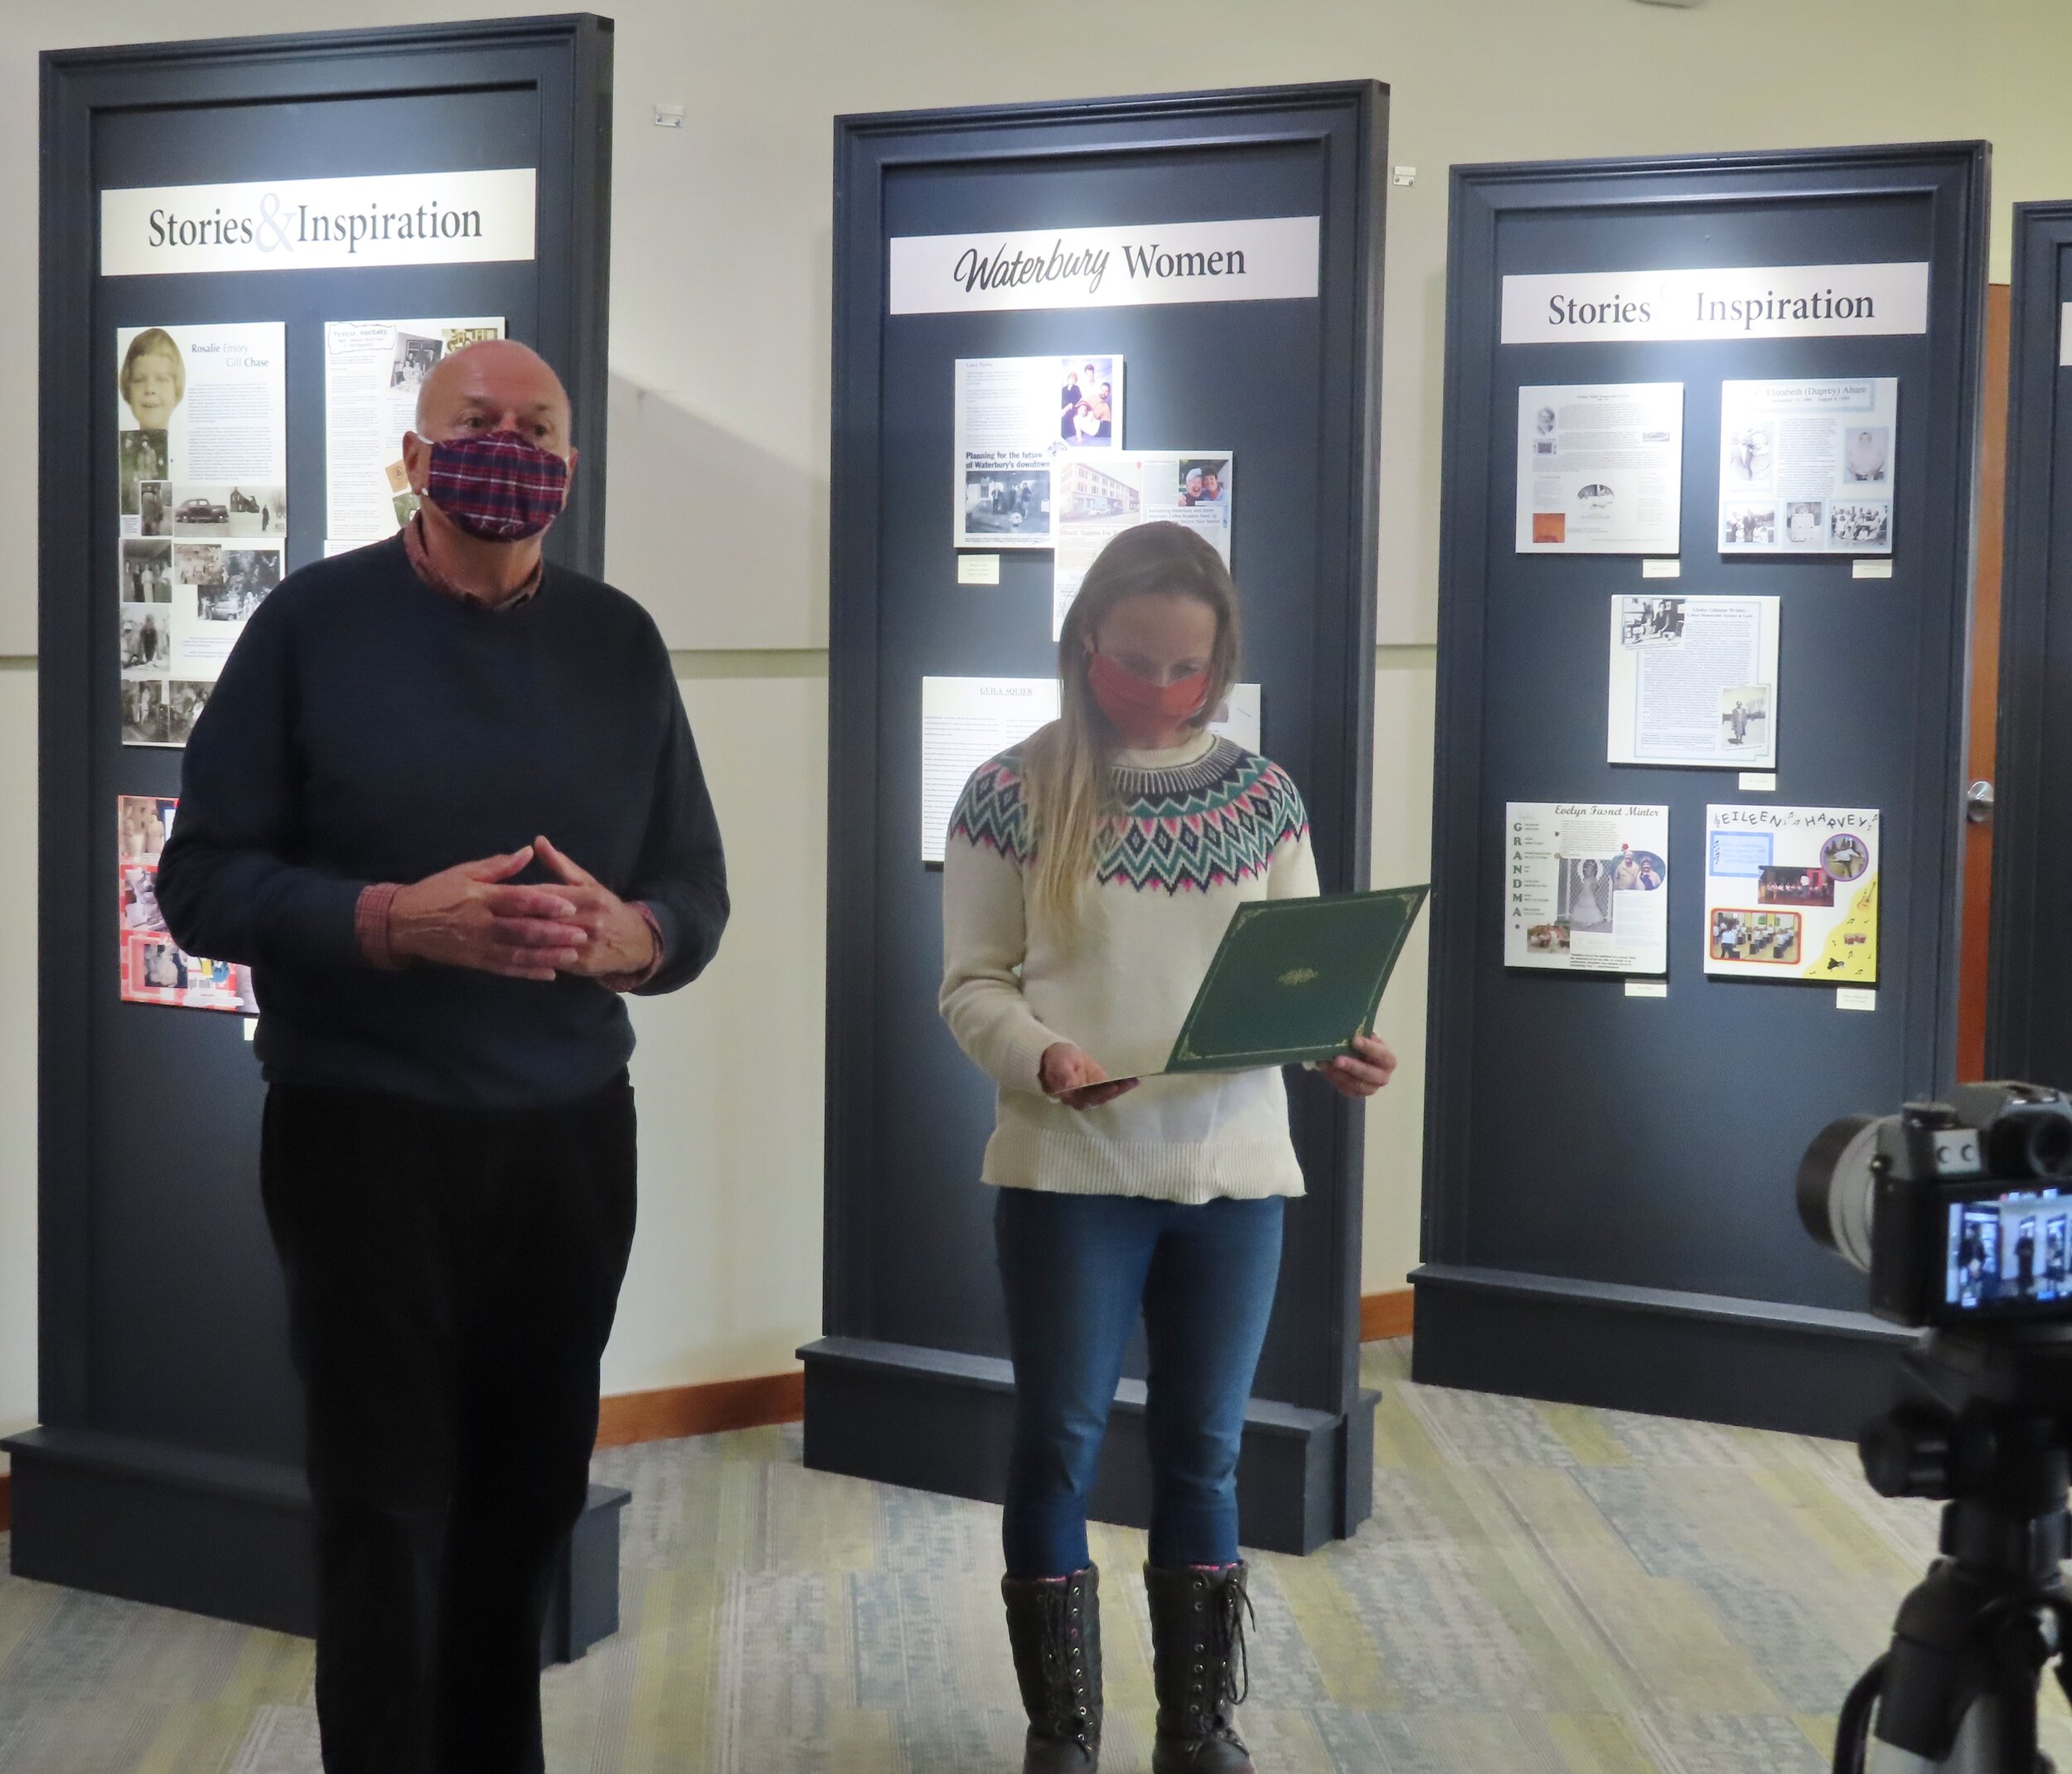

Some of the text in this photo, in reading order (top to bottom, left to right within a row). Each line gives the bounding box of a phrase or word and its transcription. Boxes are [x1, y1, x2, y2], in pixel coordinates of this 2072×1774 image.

[148, 208, 253, 247] Stories
[298, 201, 482, 254] Inspiration
[954, 238, 1247, 293] Waterbury Women
[1547, 288, 1876, 330] Stories Inspiration
[191, 343, 220, 353] Rosalie
[244, 357, 269, 367] Chase
[1766, 387, 1802, 396] Elizabeth
[966, 452, 995, 460] Planning
[997, 451, 1006, 459] for
[1009, 451, 1020, 459] the
[966, 461, 973, 469] of
[975, 461, 1014, 470] Waterbury's
[1555, 804, 1587, 817] Evelyn
[1625, 806, 1660, 817] Minter
[1721, 811, 1867, 830] EILEEN HARVEY
